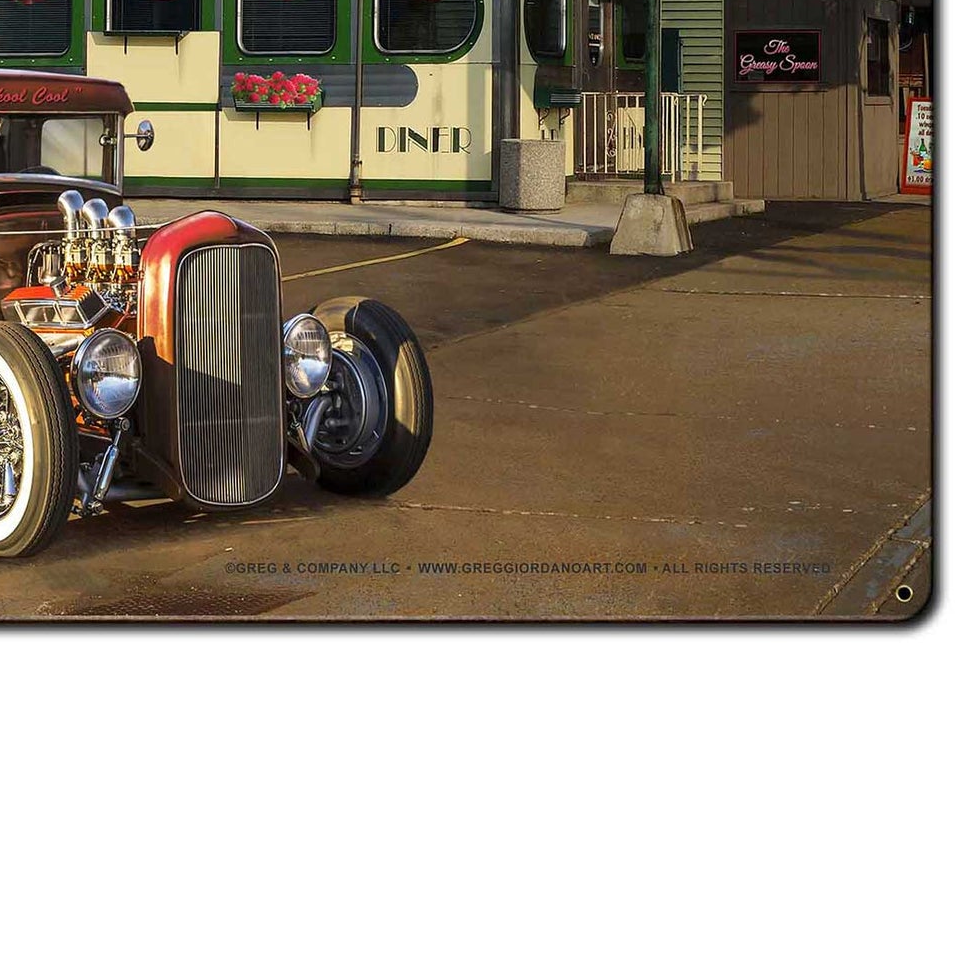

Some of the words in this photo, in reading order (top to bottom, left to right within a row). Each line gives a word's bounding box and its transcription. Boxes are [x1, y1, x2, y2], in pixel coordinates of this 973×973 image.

[763, 39, 791, 55] The
[739, 54, 778, 76] Greasy
[779, 54, 818, 74] Spoon
[32, 87, 69, 105] Cool
[375, 126, 472, 154] DINER
